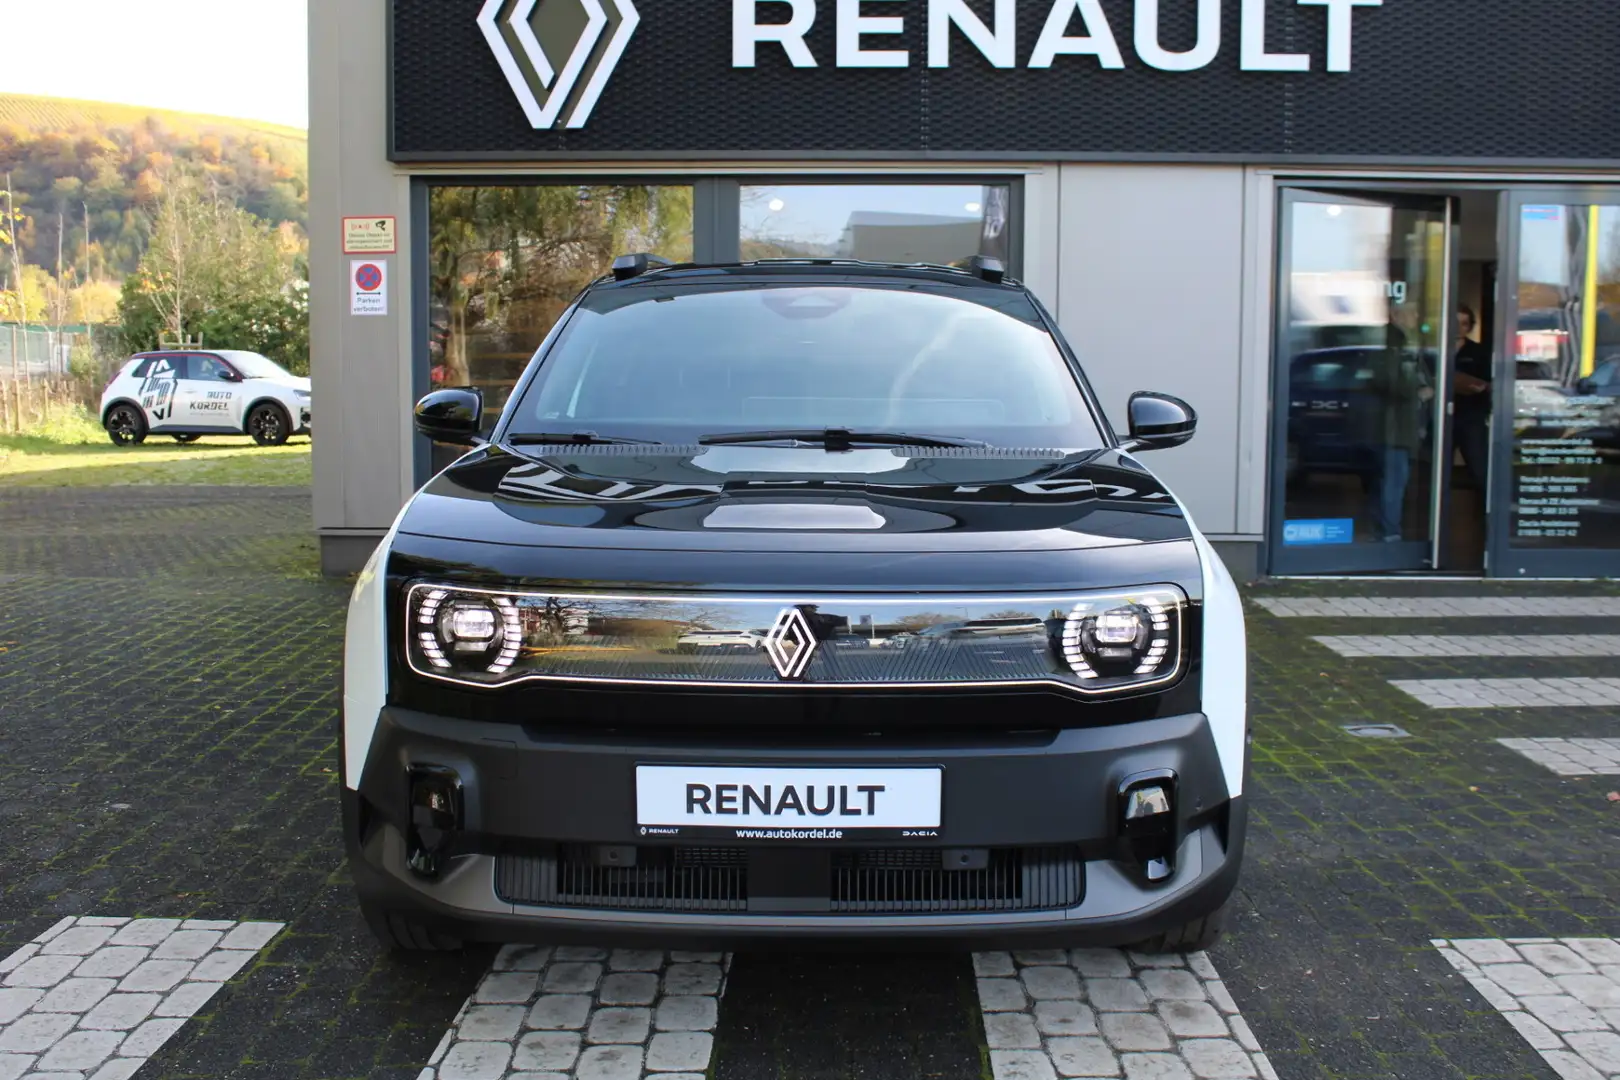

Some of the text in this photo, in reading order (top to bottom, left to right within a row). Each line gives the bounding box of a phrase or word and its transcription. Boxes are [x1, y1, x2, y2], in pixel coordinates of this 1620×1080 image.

[732, 0, 1383, 73] RENAULT
[190, 402, 229, 410] KORDEL
[686, 783, 886, 816] RENAULT
[735, 828, 843, 839] www.autokordel.de
